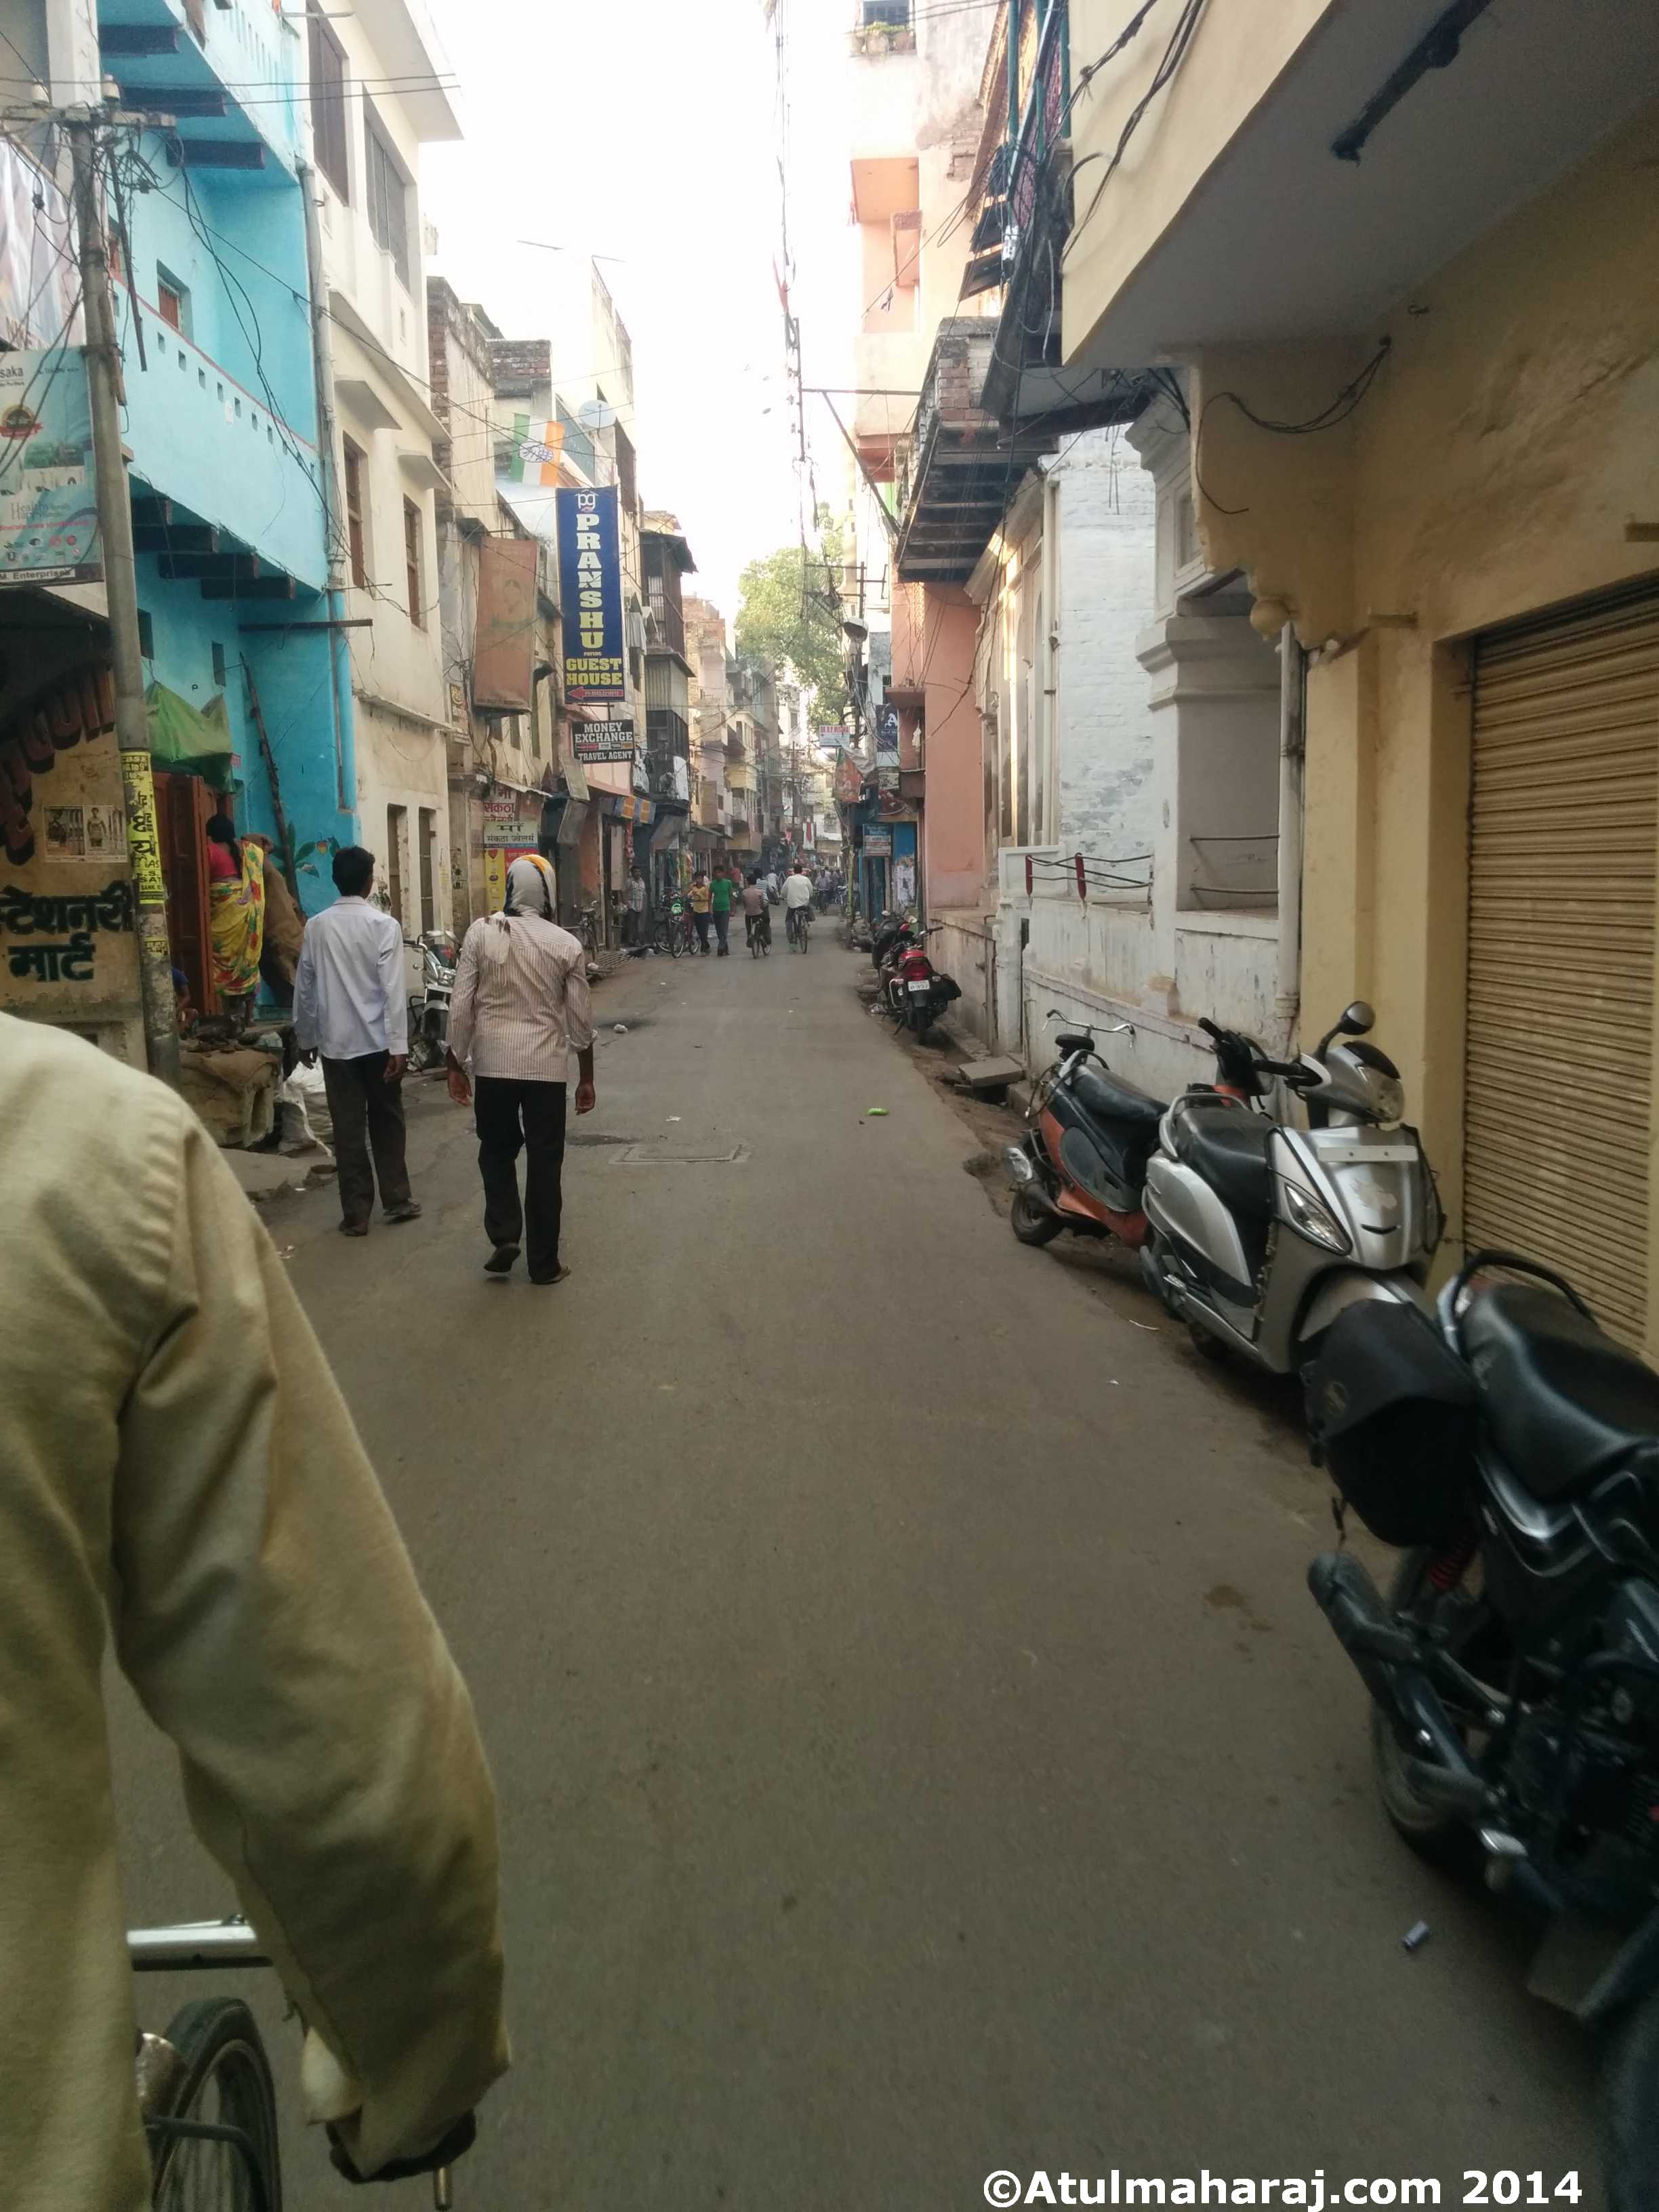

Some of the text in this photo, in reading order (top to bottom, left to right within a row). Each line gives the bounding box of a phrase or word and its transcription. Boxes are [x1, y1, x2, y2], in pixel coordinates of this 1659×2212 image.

[576, 514, 604, 649] PRANSHU
[566, 658, 622, 671] GUEST
[566, 673, 622, 685] HOUSE
[584, 722, 622, 733] MONEY
[575, 731, 633, 743] EXCHANGE
[578, 751, 632, 761] TRAVEL AGENT
[8, 933, 97, 982] मार्ट
